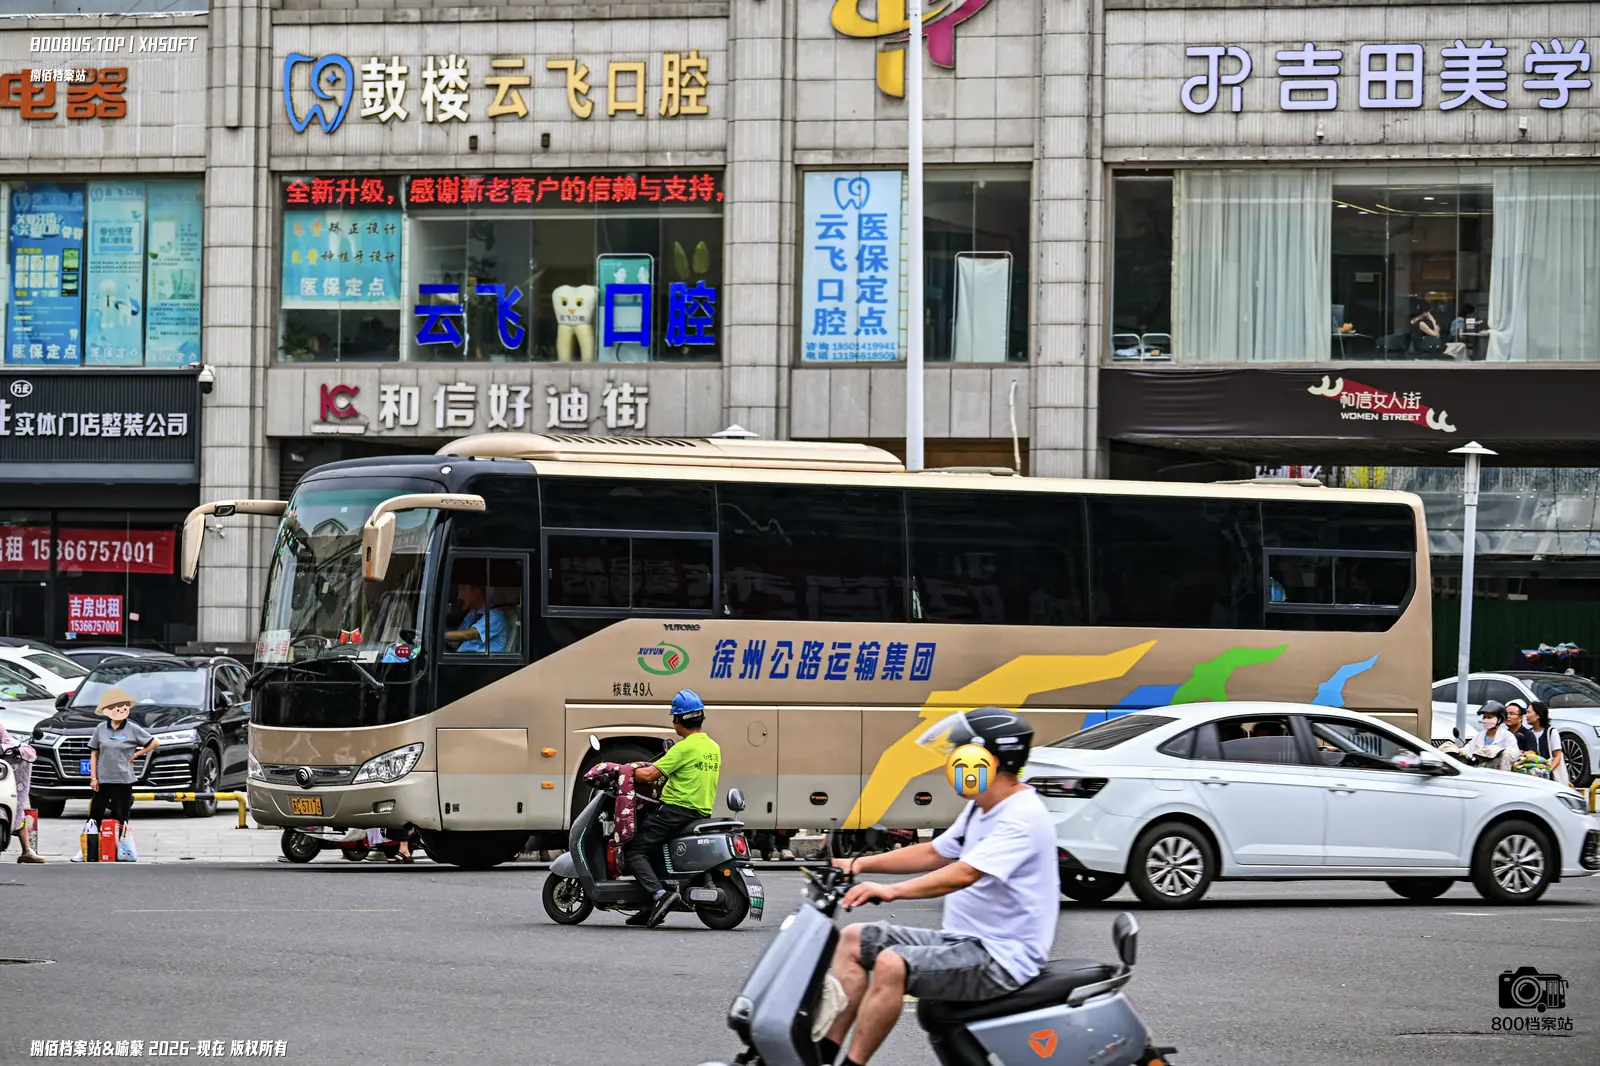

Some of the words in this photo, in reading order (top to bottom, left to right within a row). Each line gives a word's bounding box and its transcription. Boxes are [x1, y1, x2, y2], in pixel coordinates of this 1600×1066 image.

[1276, 39, 1592, 110] 吉田美学
[360, 49, 709, 123] 鼓楼云飞口腔
[812, 213, 848, 336] 云飞口腔
[854, 213, 889, 336] 医保定点
[300, 276, 386, 296] 医保定点
[414, 281, 717, 349] 云飞口腔
[13, 344, 78, 360] 医保定点
[379, 381, 649, 431] 和信好迪街
[1340, 391, 1422, 410] 和信女人街
[14, 412, 188, 437] 实体门店整装公司
[1340, 412, 1379, 421] WOMEN
[1382, 413, 1422, 421] STREET
[70, 596, 120, 618] 吉房出租
[71, 619, 120, 633] 15366757001
[663, 623, 701, 632] YUTONG
[637, 647, 665, 656] XUYUN
[709, 639, 937, 681] 徐州公路运输集团
[612, 681, 654, 698] 核载49人
